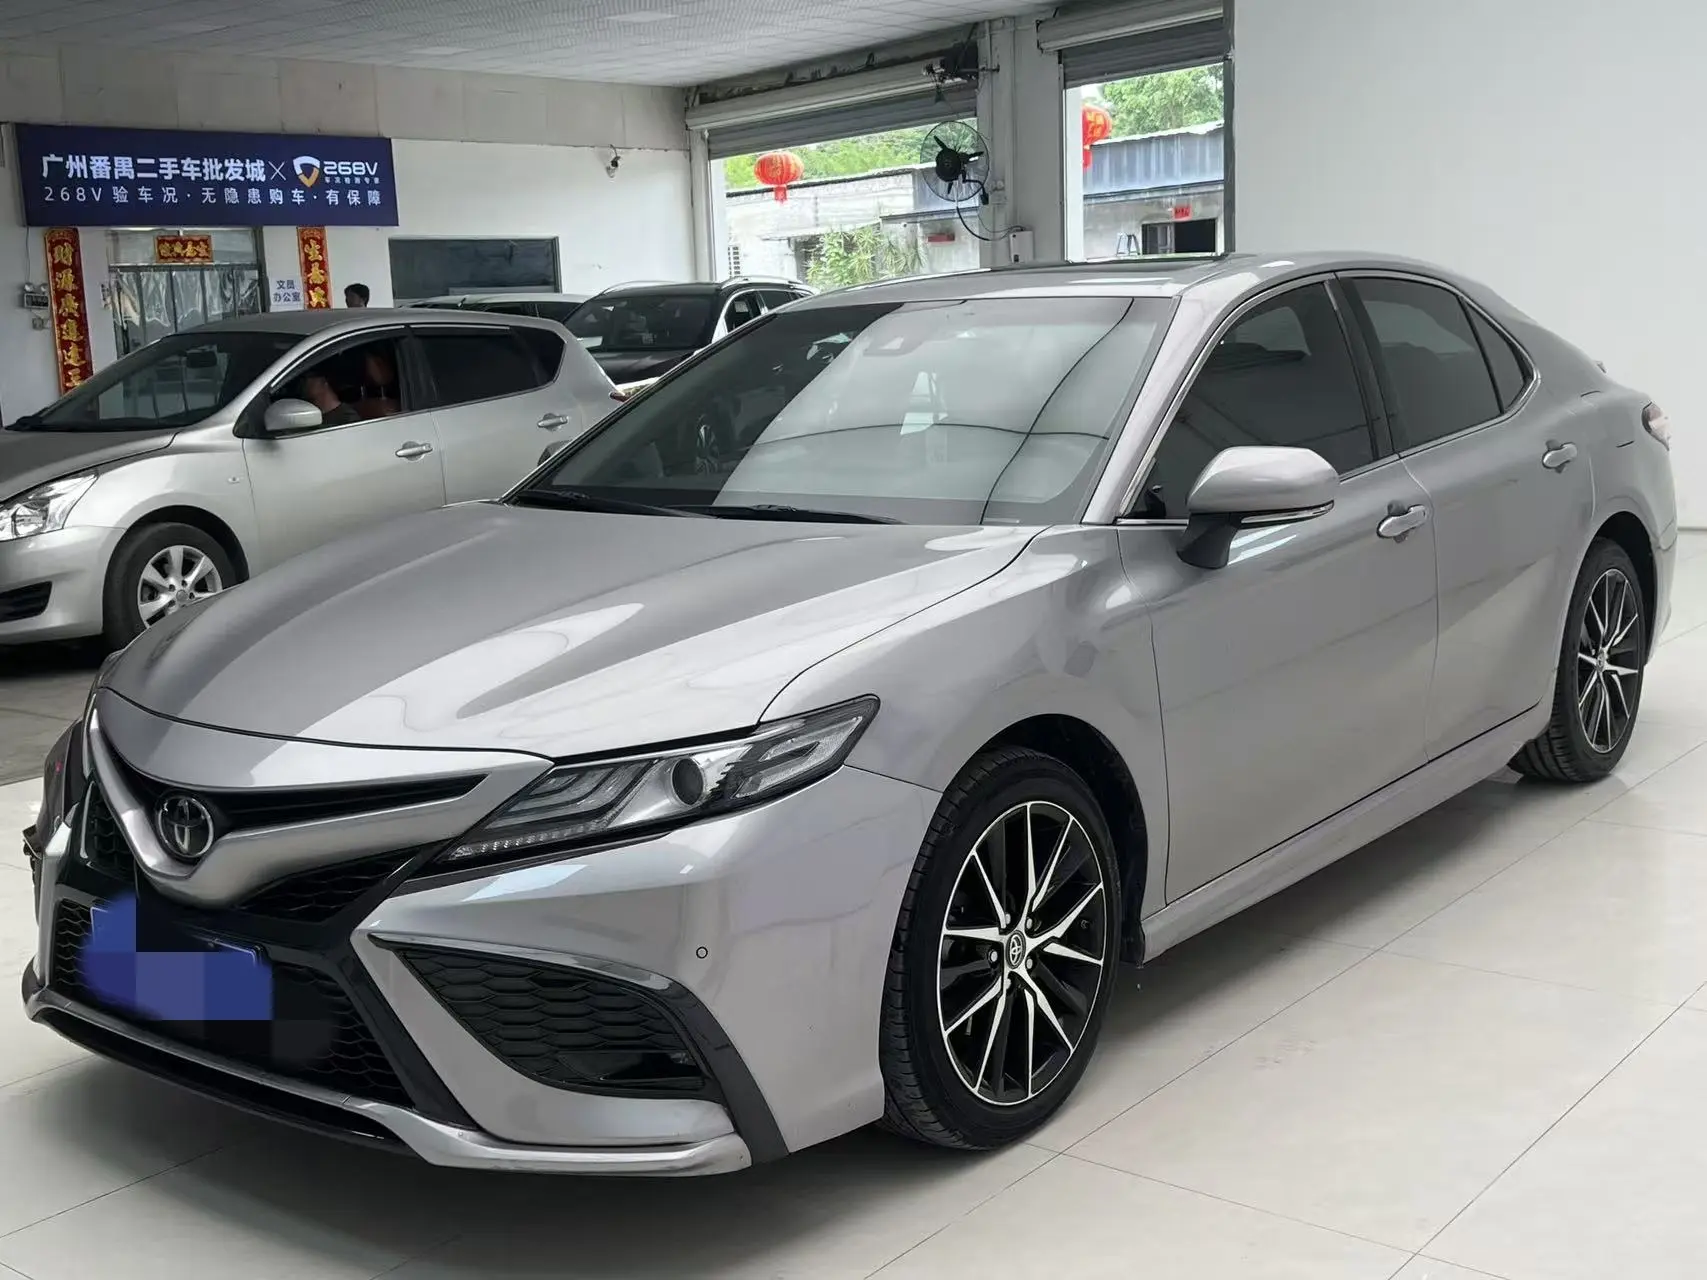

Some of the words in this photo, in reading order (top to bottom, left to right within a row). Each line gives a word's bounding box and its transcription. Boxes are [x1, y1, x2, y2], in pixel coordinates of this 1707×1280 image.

[42, 154, 266, 182] 广州番禺二手车批发城
[323, 161, 378, 175] 268V
[273, 292, 301, 302] 办公室
